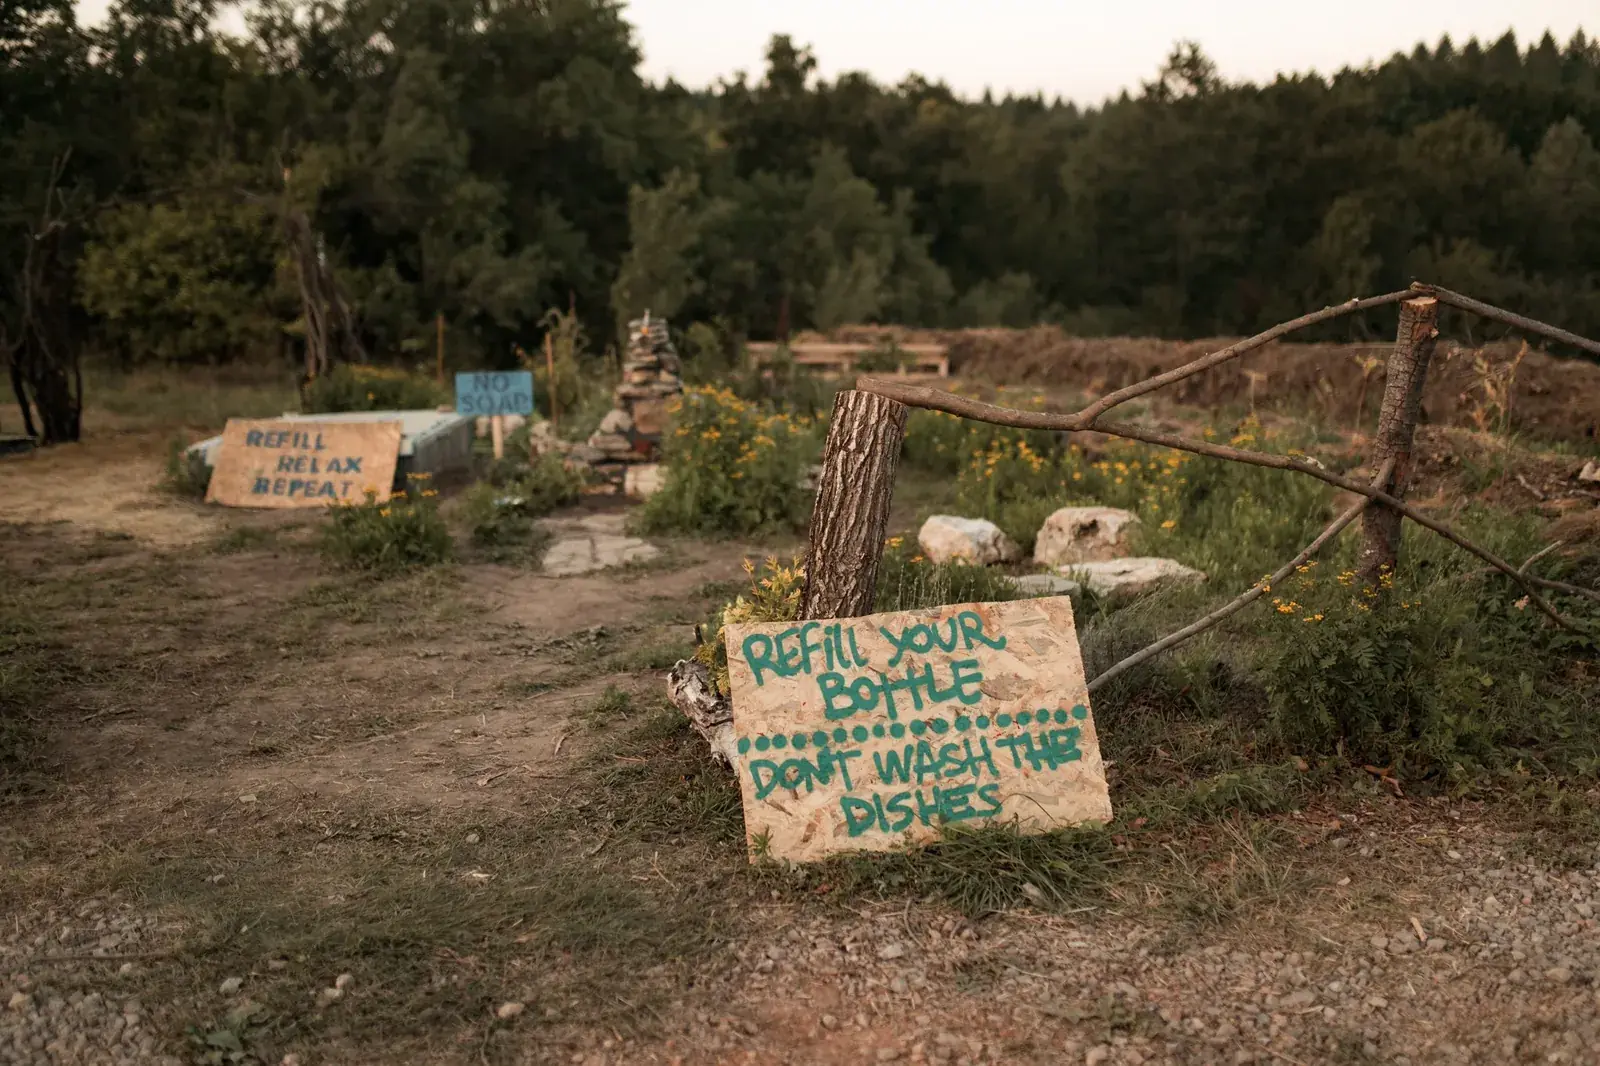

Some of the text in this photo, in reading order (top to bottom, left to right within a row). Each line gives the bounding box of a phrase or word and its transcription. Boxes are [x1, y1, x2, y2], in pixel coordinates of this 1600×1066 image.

[473, 374, 510, 392] NO
[246, 429, 327, 450] REFILL
[276, 454, 363, 473] RELAX
[251, 476, 354, 497] REPEAT
[873, 735, 999, 785] WASH
[995, 727, 1082, 771] THE
[840, 783, 1003, 837] DISHES
